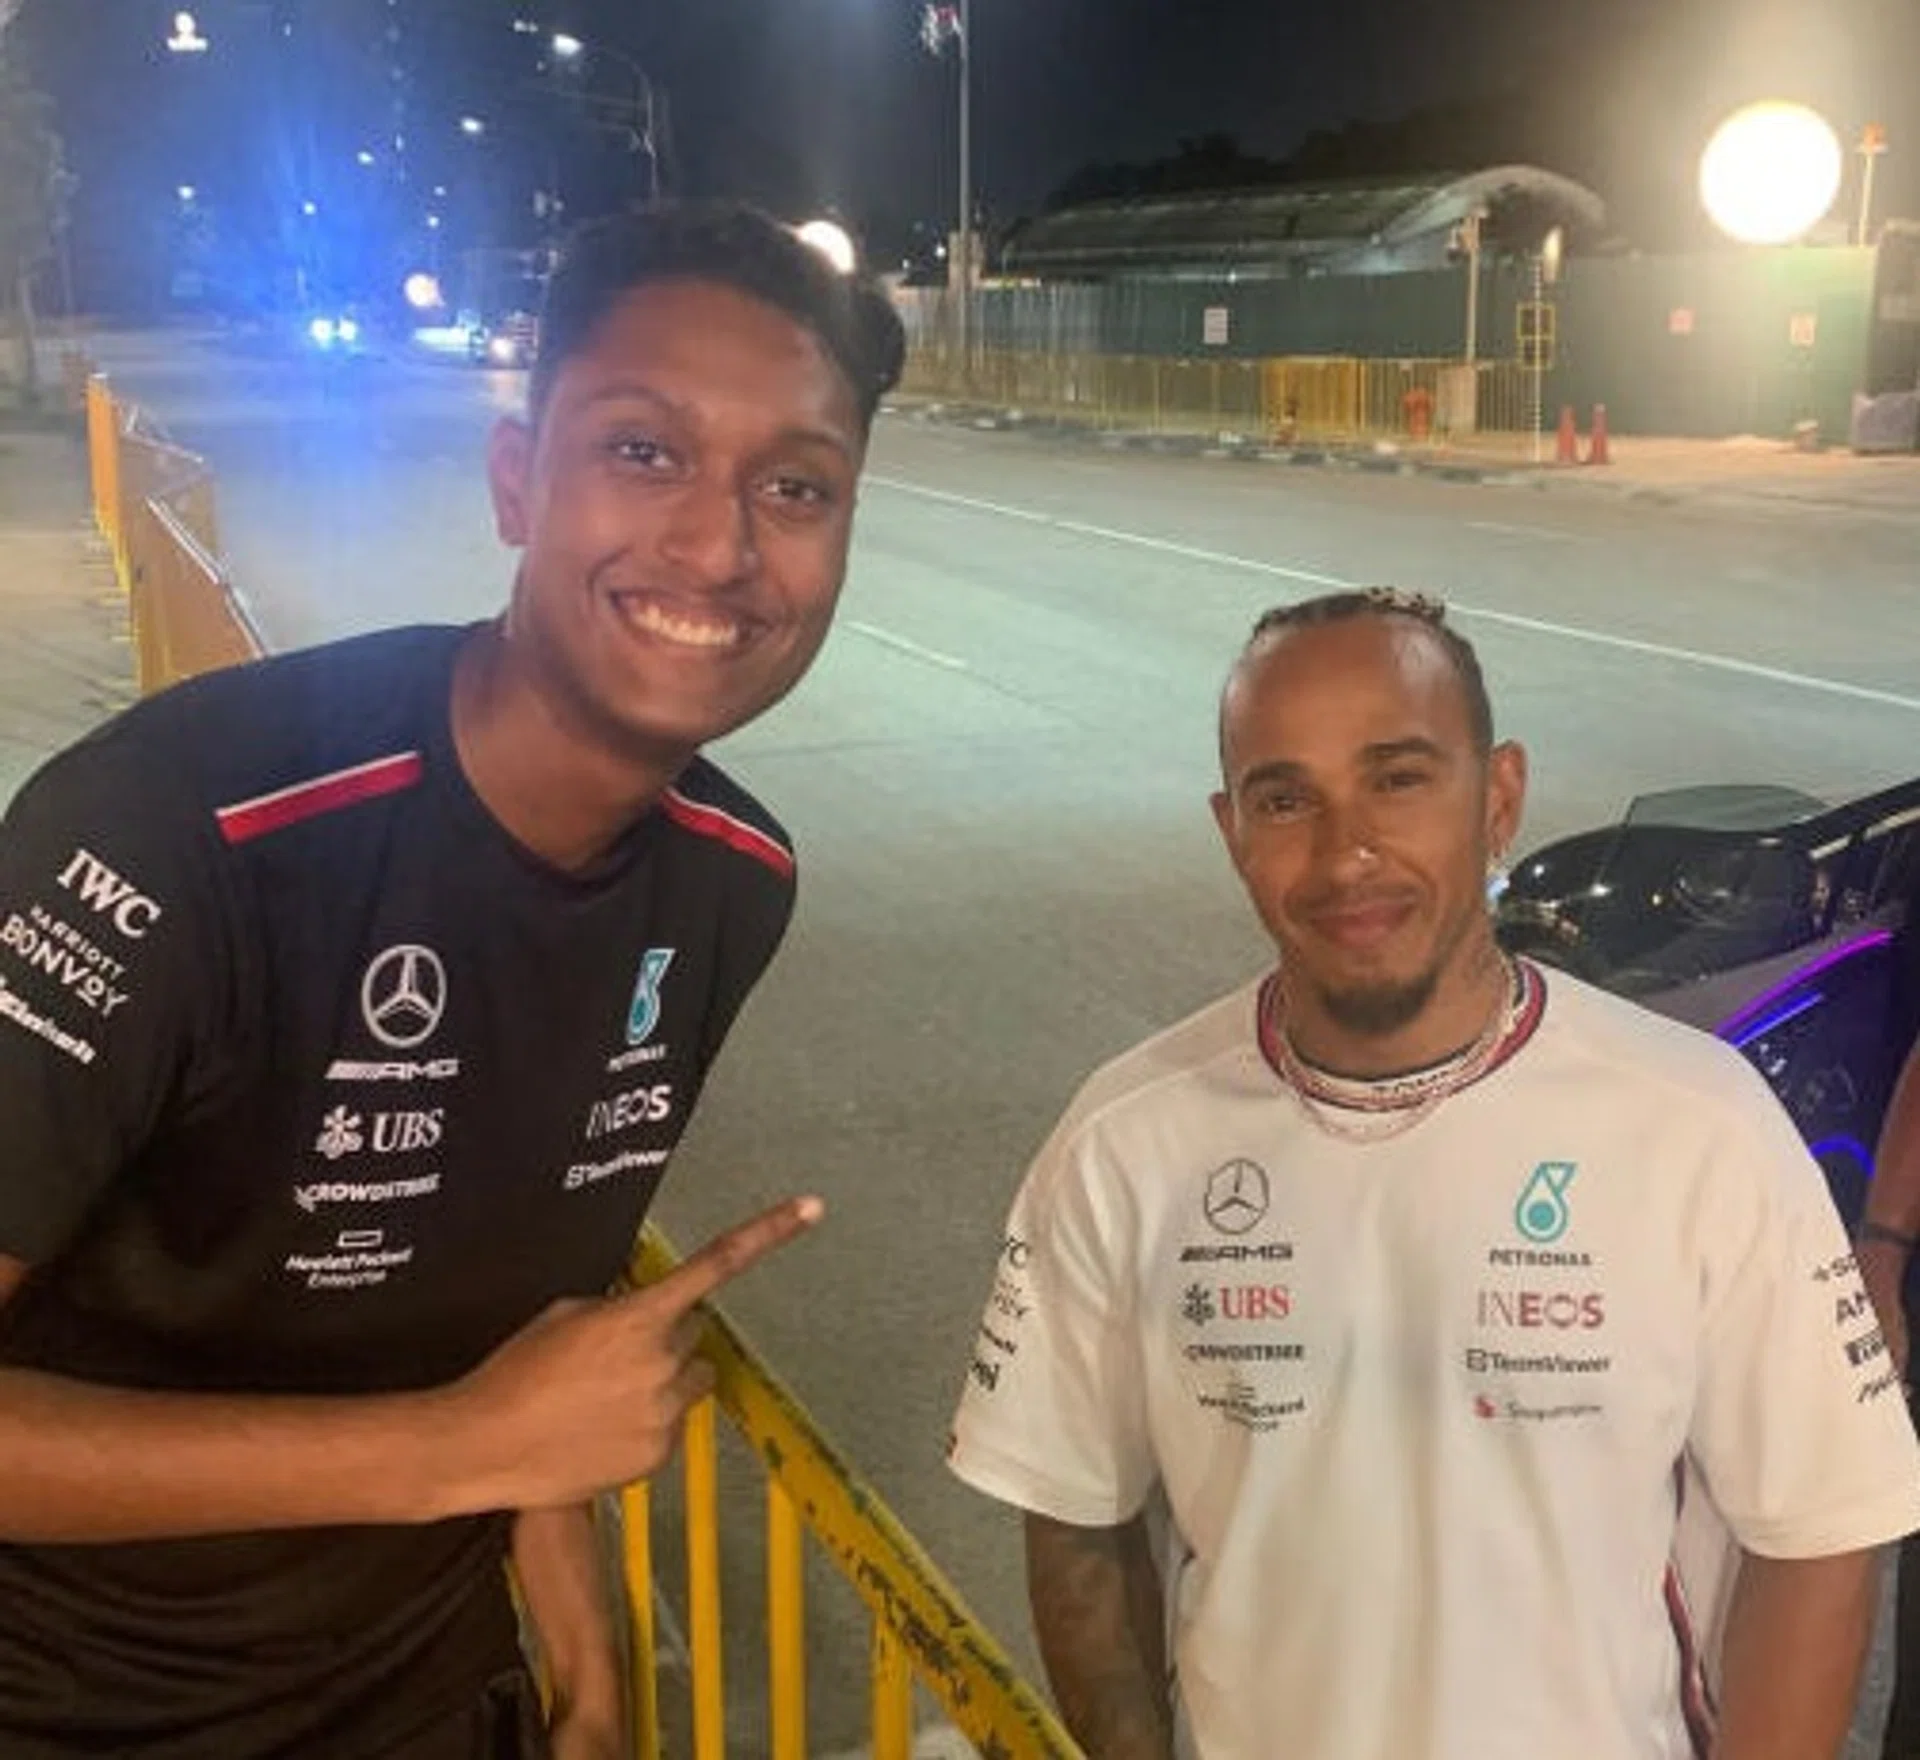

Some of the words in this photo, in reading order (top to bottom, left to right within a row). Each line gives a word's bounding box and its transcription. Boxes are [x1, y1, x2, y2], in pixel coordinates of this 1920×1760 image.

[57, 849, 162, 938] IWC
[0, 914, 129, 1017] BONVOY
[372, 1108, 445, 1152] UBS
[1220, 1284, 1292, 1320] UBS
[1478, 1291, 1605, 1329] INEOS
